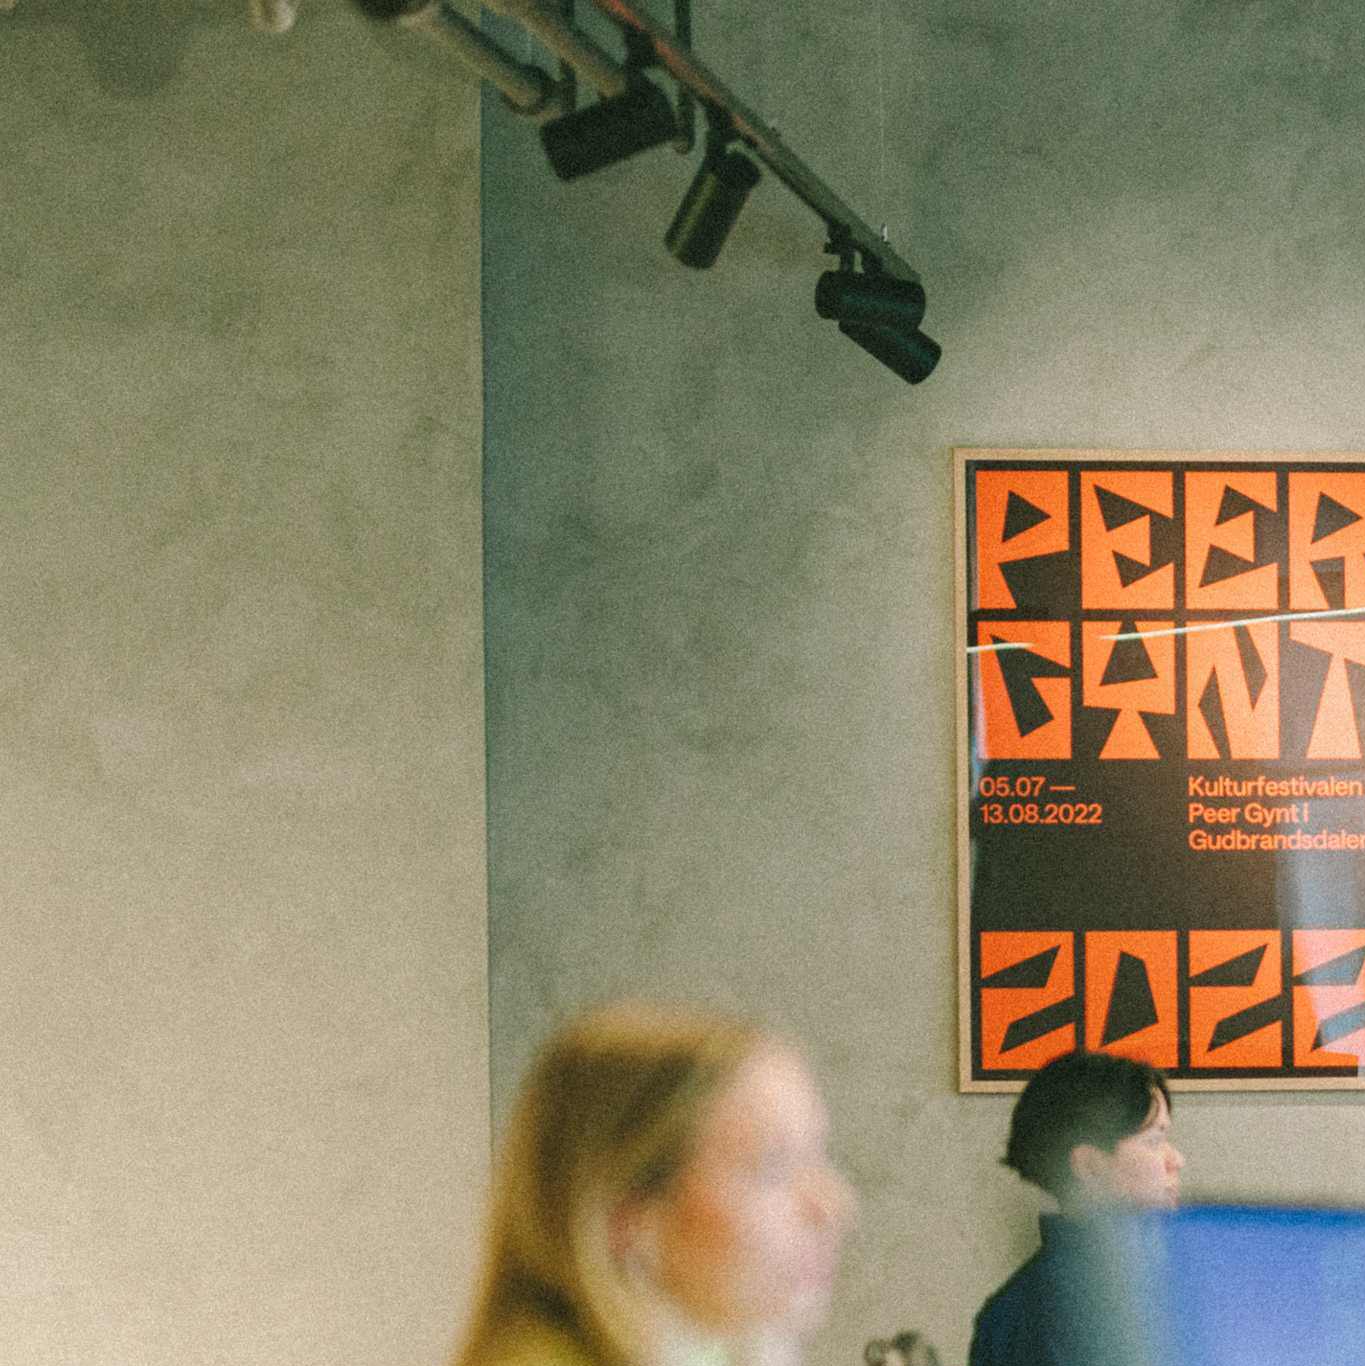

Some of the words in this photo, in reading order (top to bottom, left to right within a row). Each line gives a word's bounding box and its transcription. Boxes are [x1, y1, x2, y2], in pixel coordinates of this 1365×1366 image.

[979, 776, 1046, 797] 05.07
[1188, 776, 1365, 798] Kulturfestivalen
[980, 803, 1103, 825] 13.08.2022
[1188, 803, 1239, 825] Peer
[1244, 803, 1297, 829] Gynt
